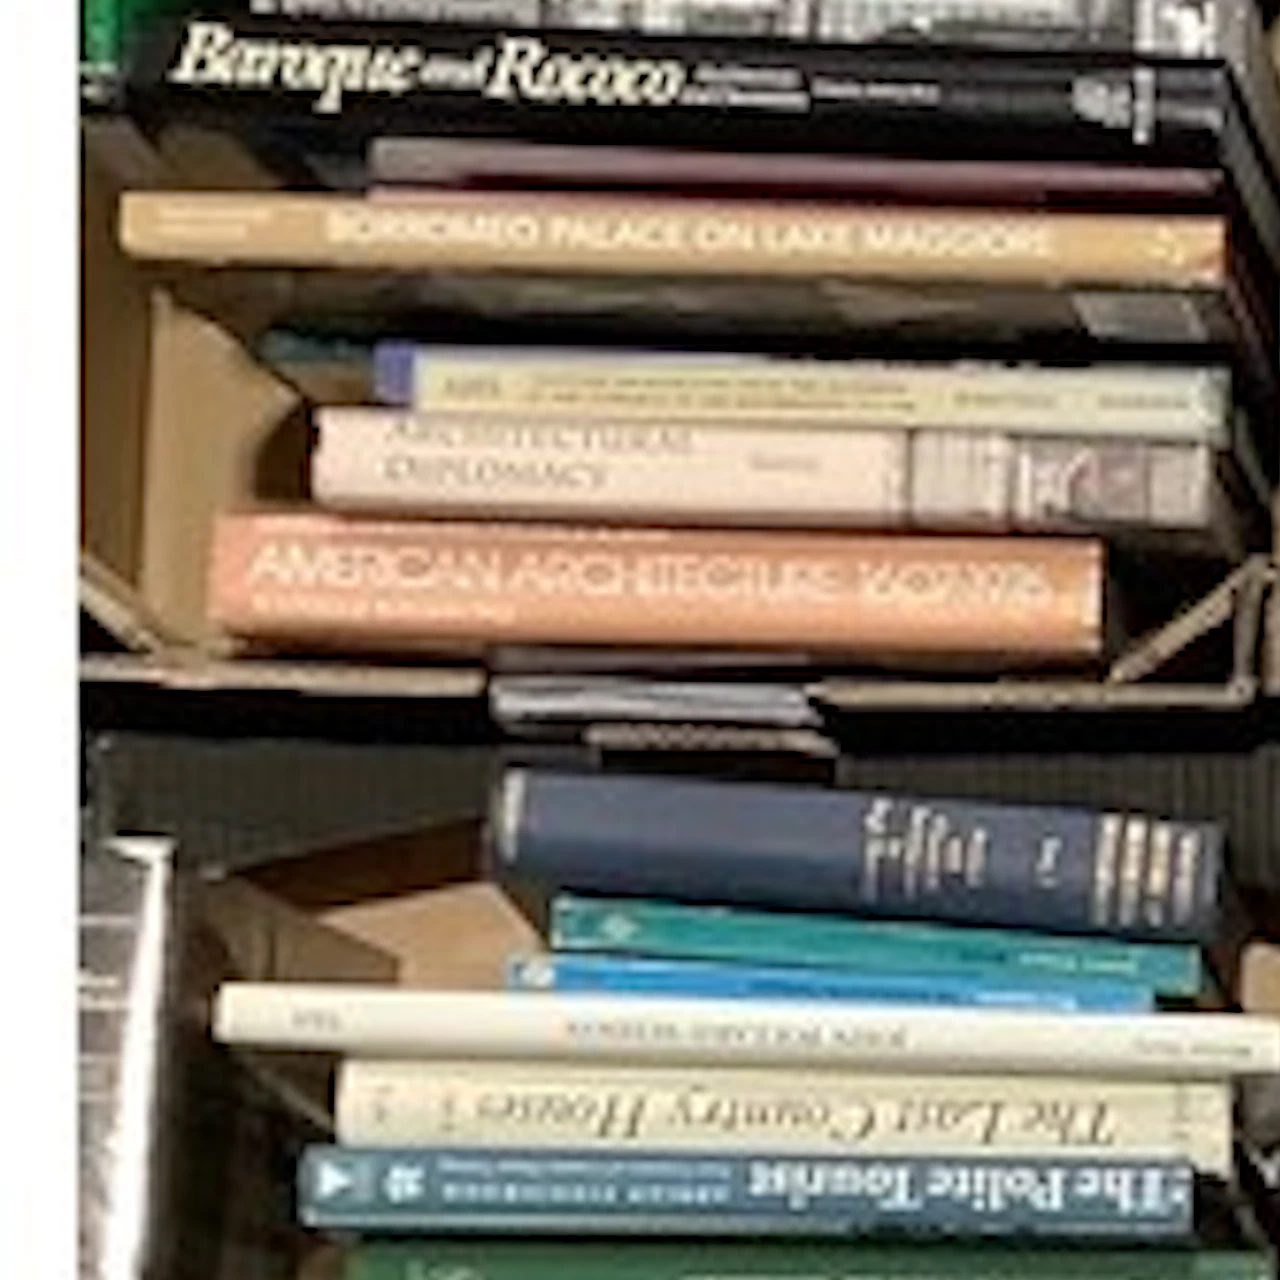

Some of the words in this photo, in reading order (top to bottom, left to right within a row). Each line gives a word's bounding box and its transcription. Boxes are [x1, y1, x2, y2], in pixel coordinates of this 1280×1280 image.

[166, 22, 421, 112] Baroque
[481, 36, 686, 103] Rococo
[695, 216, 756, 249] ON
[246, 544, 500, 594] AMERICAN
[475, 1092, 645, 1141] Houses
[668, 1084, 876, 1146] Country
[896, 1097, 1001, 1146] Last
[1018, 1100, 1116, 1148] The
[747, 1162, 919, 1211] Tourist
[926, 1163, 1065, 1213] Polite
[1072, 1163, 1168, 1214] The
